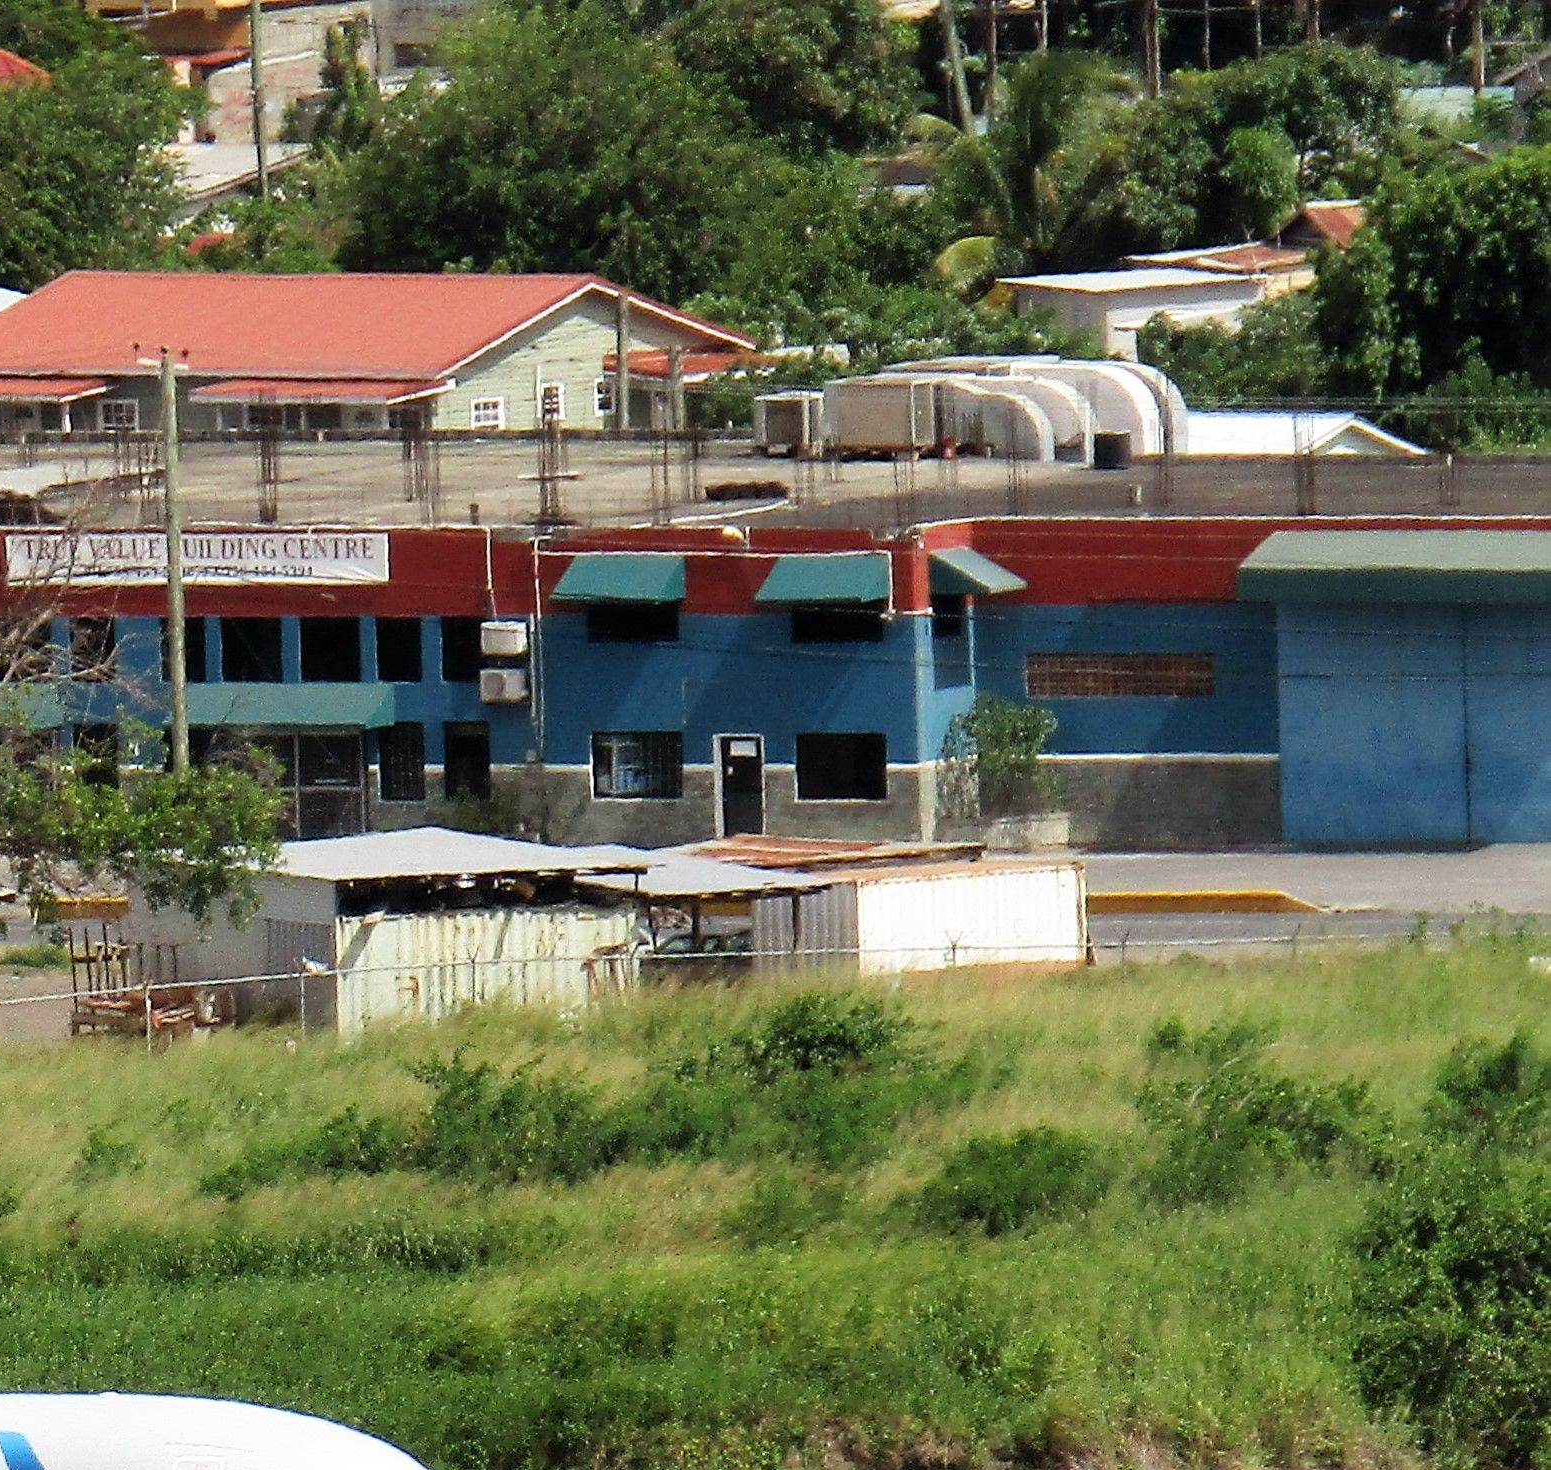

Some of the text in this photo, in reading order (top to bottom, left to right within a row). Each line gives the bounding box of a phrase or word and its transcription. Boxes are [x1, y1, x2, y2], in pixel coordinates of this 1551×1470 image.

[88, 537, 160, 560] VALUE
[181, 537, 277, 561] UILDING
[283, 537, 375, 560] CENTRE
